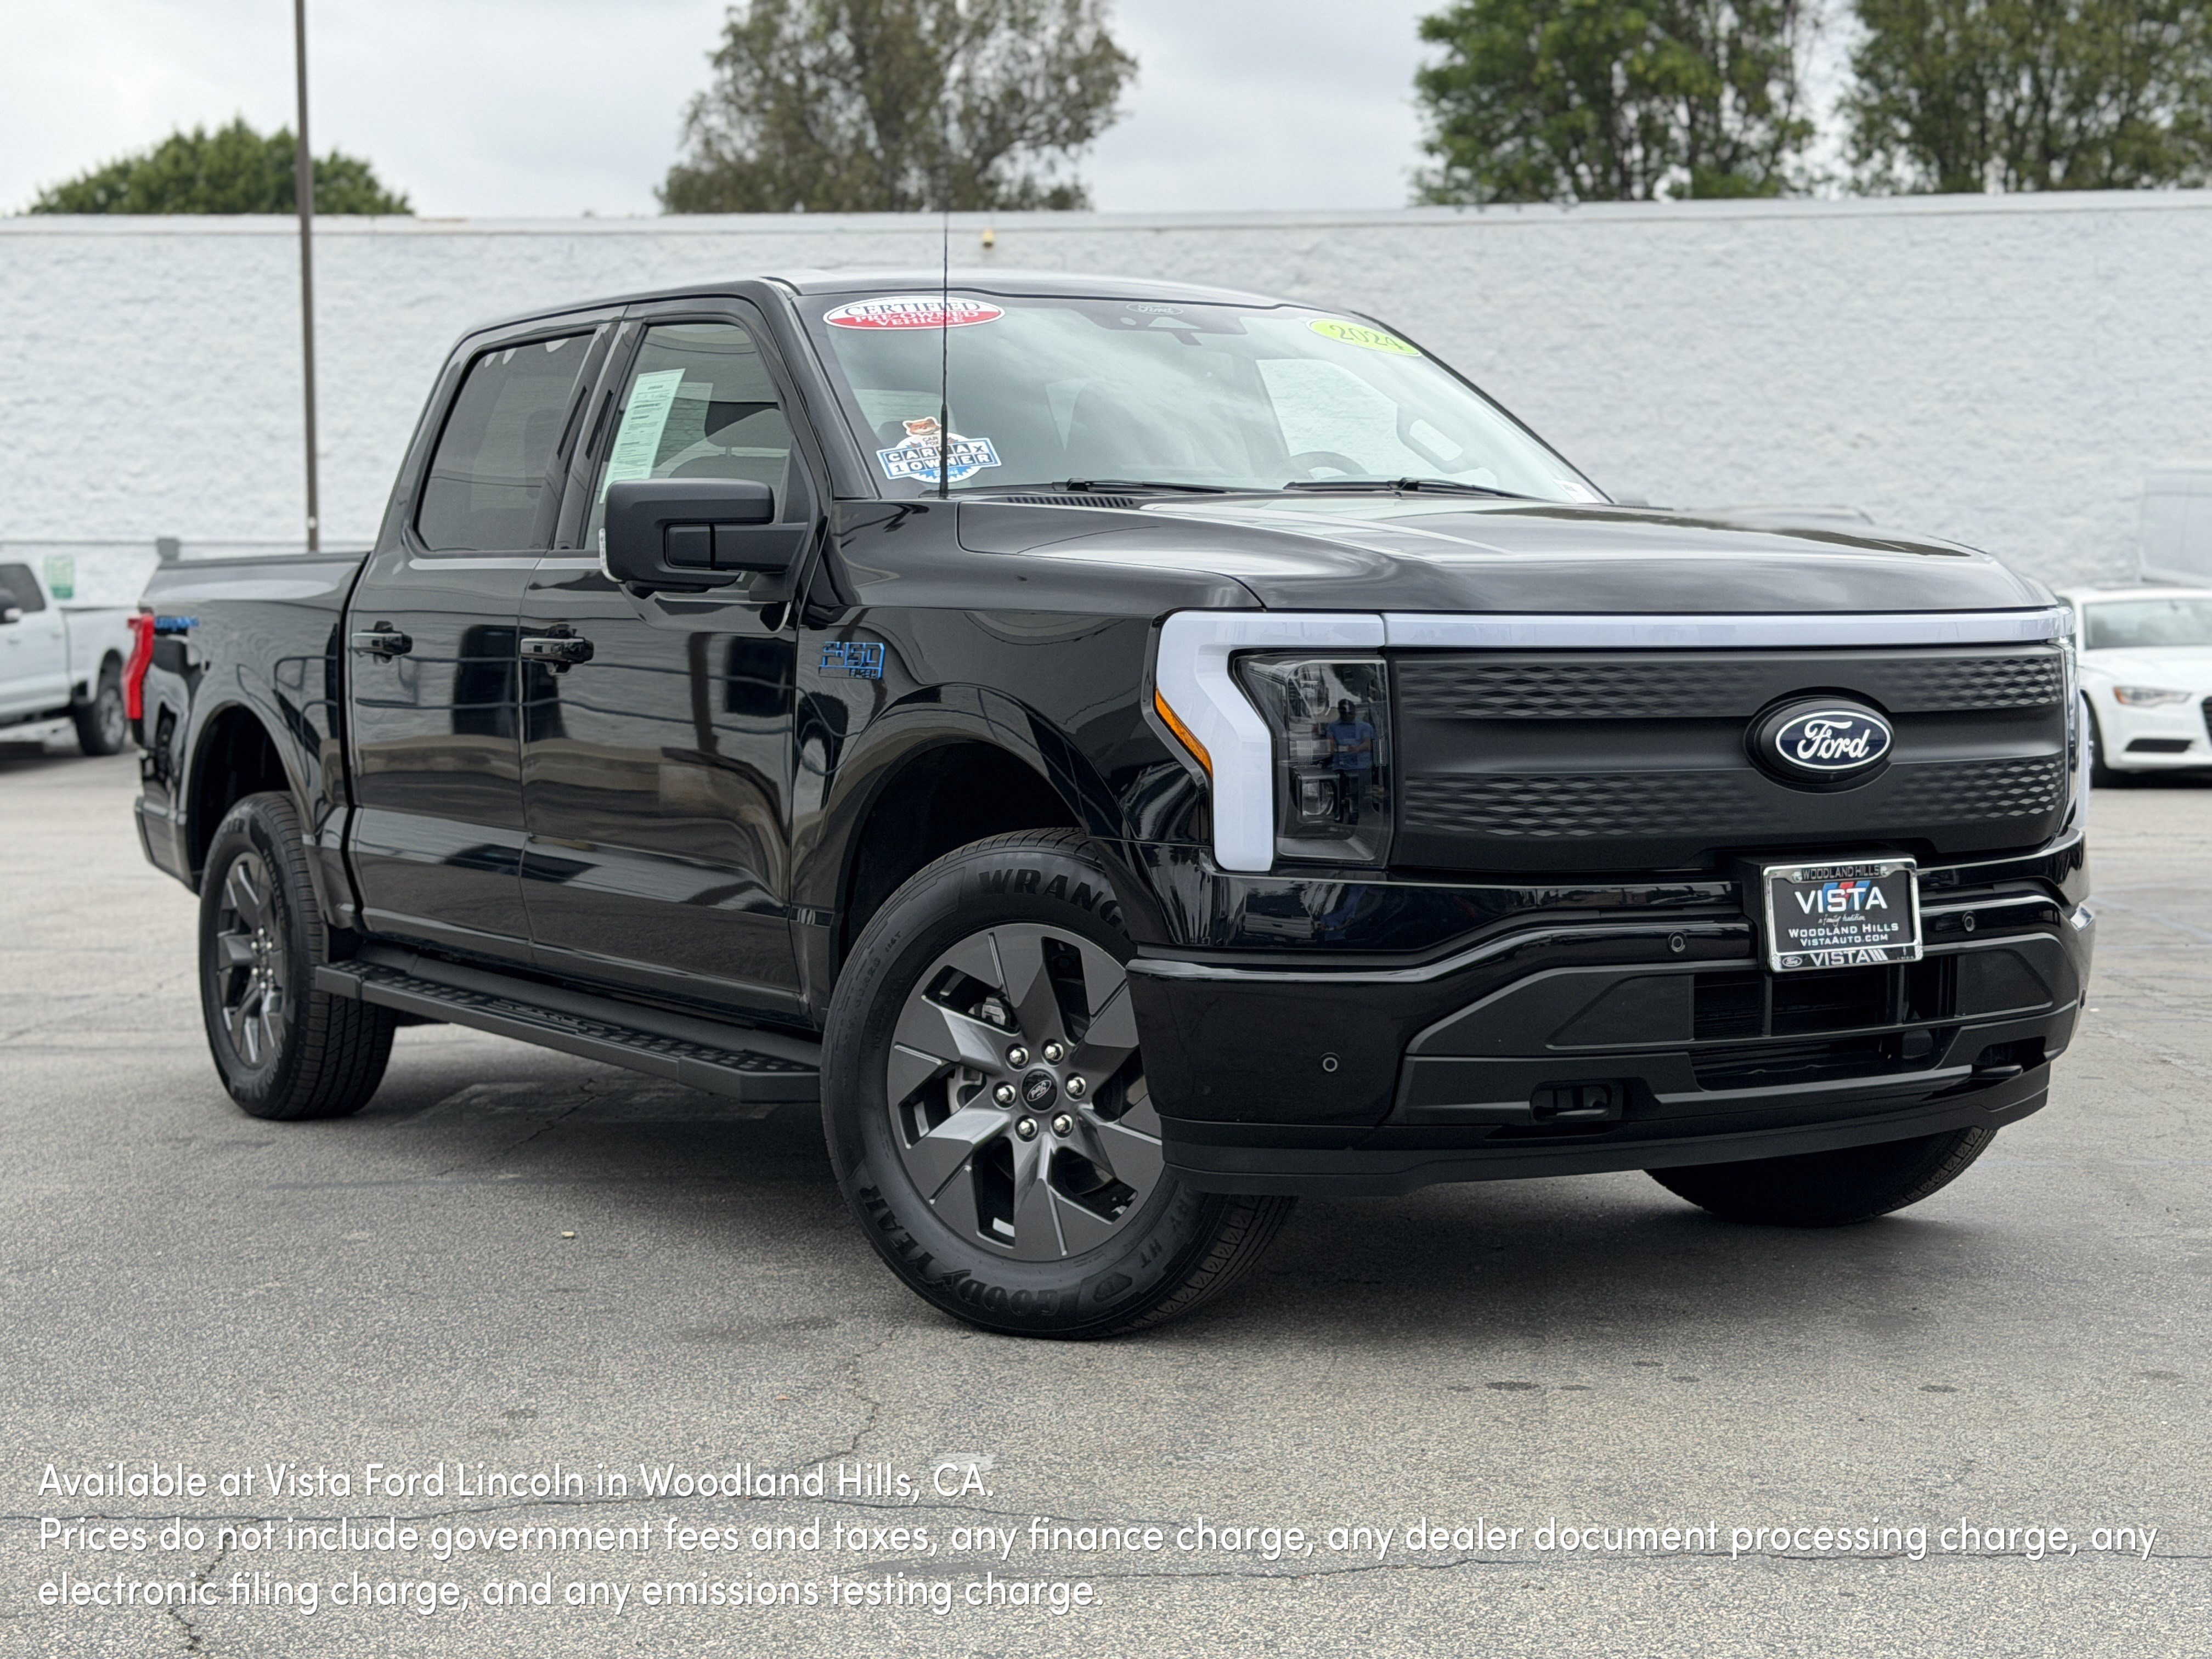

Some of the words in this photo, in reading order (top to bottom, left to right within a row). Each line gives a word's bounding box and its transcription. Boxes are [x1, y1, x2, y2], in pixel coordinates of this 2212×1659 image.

[844, 302, 980, 317] CERTIFIED
[855, 311, 979, 323] PRE-OWNED
[876, 316, 966, 326] VEHICLE
[1329, 325, 1406, 351] 2024
[888, 445, 984, 462] CARAX
[910, 454, 991, 472] OWNER
[1797, 719, 1871, 759] Ford
[1803, 866, 1854, 880] WOODLAND
[1855, 865, 1880, 877] HILLS
[978, 868, 1124, 928] WRANG
[1795, 886, 1888, 915] VISTA
[1788, 925, 1858, 939] WOODLAND
[1862, 923, 1899, 934] HILLS
[1810, 949, 1870, 967] VISTA
[858, 1184, 1061, 1316] GOODYEAR
